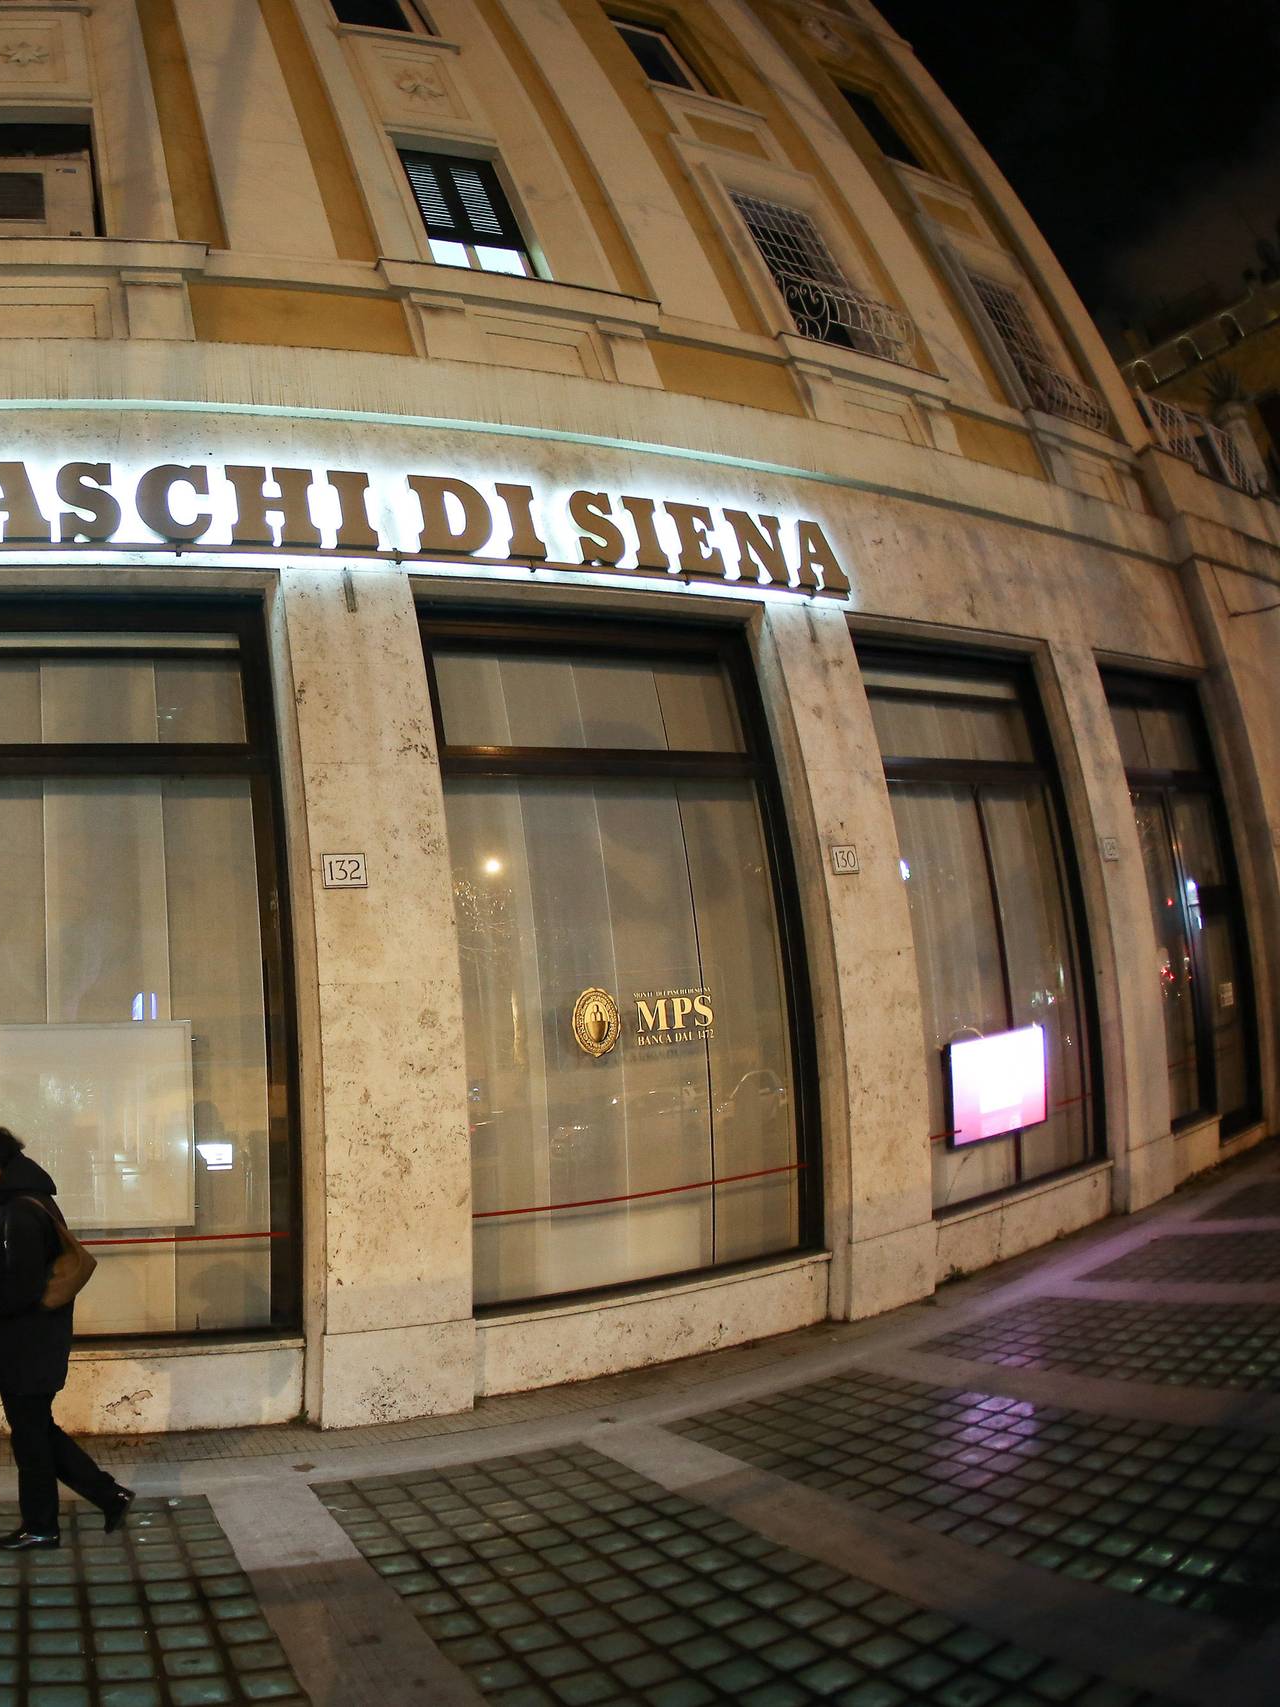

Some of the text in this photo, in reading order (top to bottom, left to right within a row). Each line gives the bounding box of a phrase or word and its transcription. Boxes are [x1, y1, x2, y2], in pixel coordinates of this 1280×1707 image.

[407, 475, 547, 559] DI
[567, 490, 851, 594] SIENA
[328, 859, 361, 881] 132
[835, 850, 856, 868] 130
[636, 994, 714, 1033] MPS
[637, 1034, 672, 1046] BANCA
[675, 1031, 695, 1042] DAL
